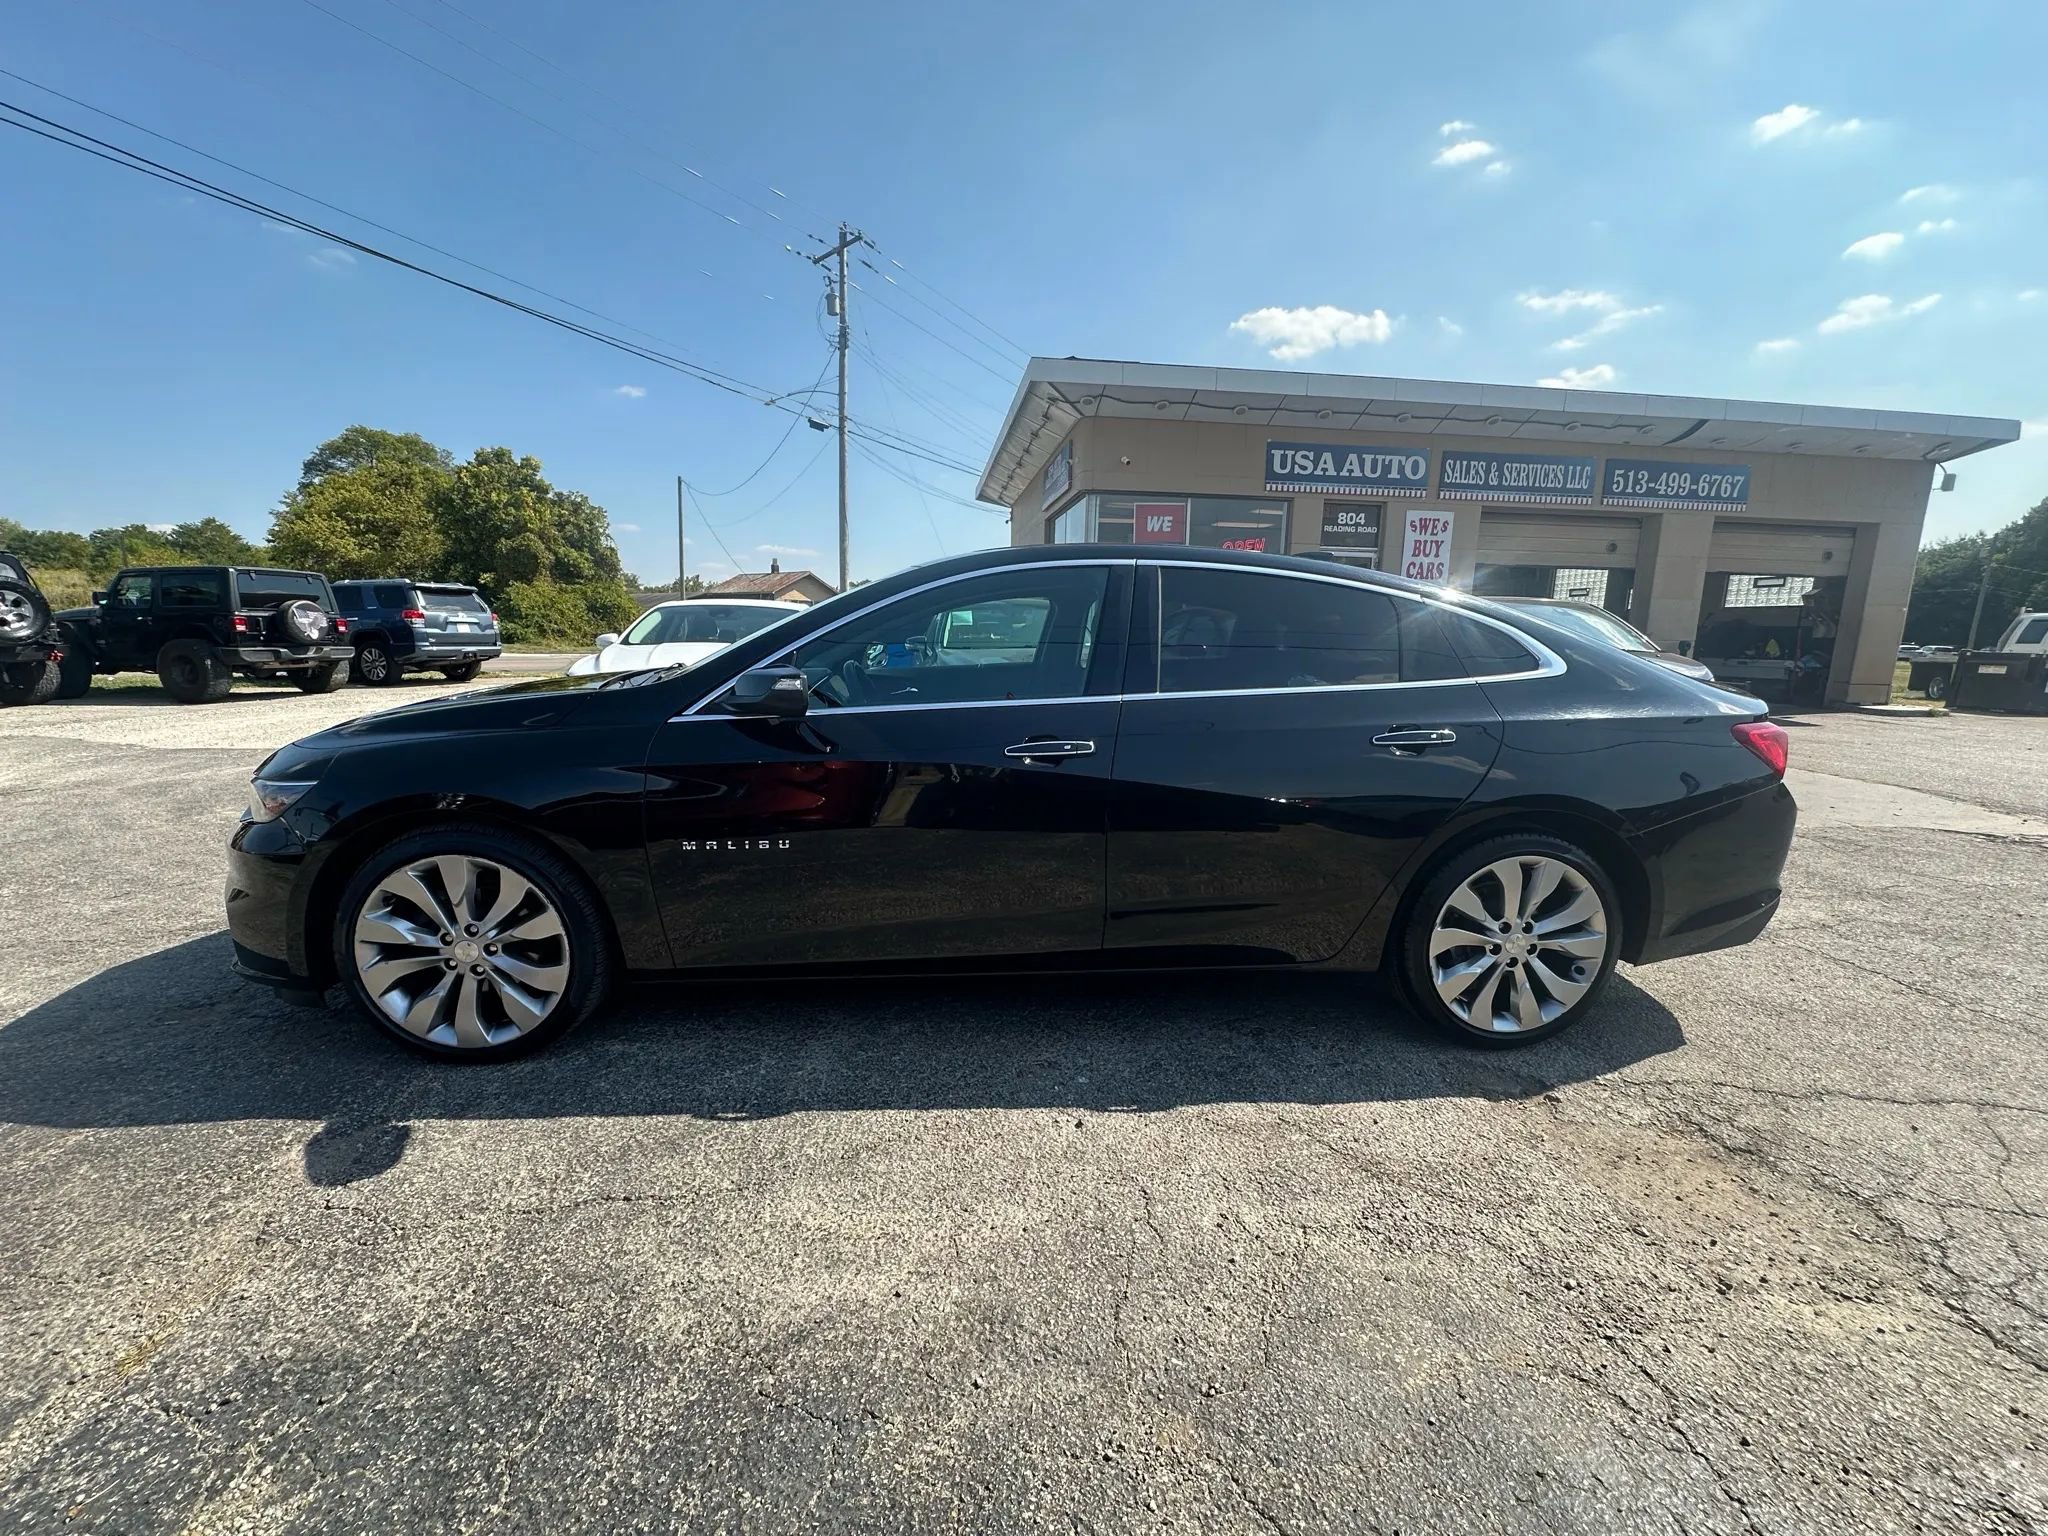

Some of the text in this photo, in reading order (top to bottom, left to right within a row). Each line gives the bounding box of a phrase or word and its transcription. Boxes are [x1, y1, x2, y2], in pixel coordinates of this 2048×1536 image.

[1271, 449, 1426, 480] USA AUTO
[1444, 459, 1591, 489] SALES & SERVICES LLC
[1612, 469, 1745, 498] 513-499-6767
[1146, 515, 1173, 532] WE
[1337, 512, 1366, 525] 804
[1323, 525, 1356, 533] READING
[1411, 539, 1444, 558] BUY
[1405, 561, 1444, 580] CARS
[682, 839, 790, 850] MALIBU
